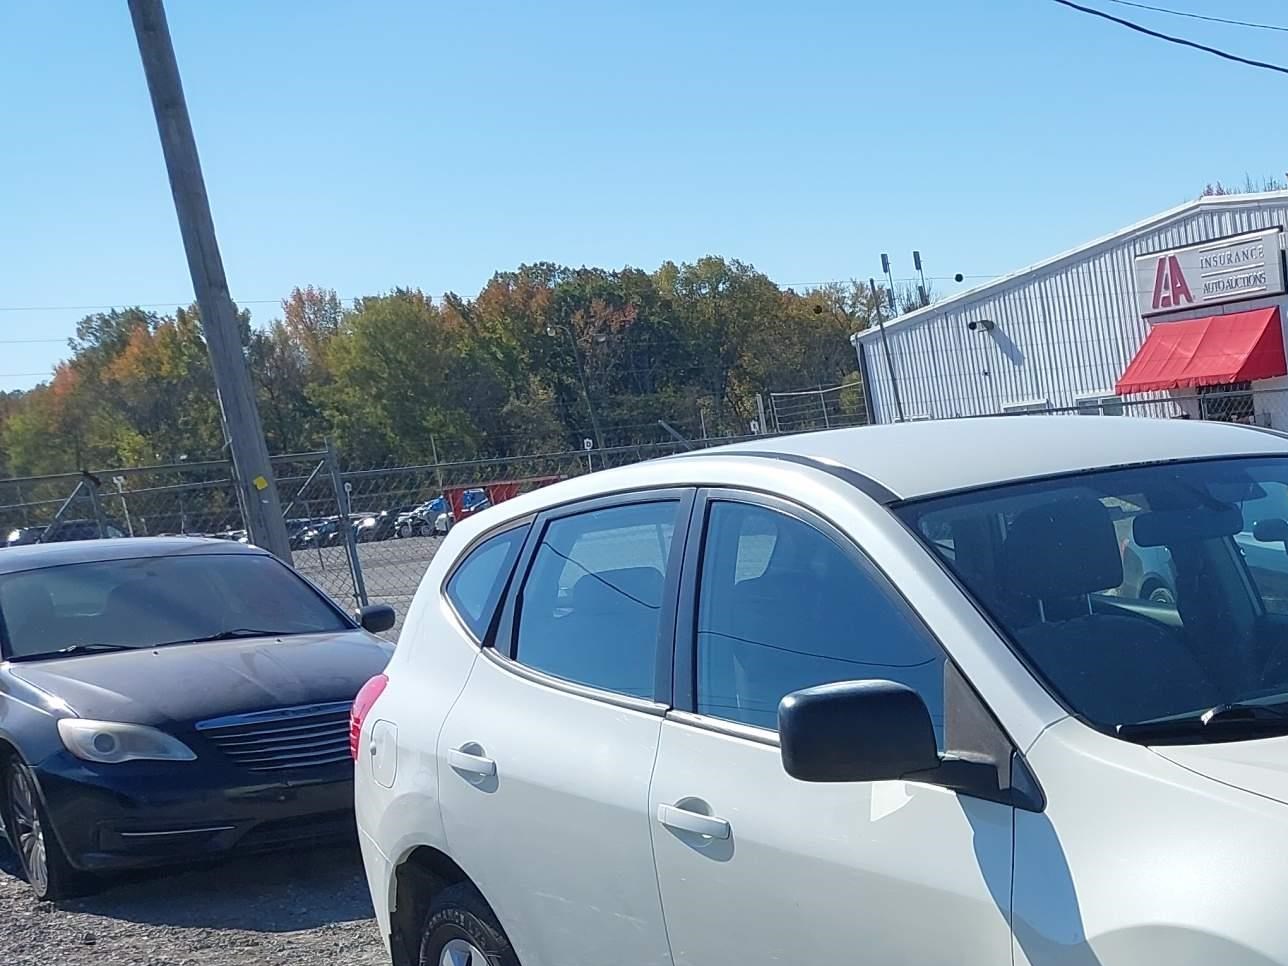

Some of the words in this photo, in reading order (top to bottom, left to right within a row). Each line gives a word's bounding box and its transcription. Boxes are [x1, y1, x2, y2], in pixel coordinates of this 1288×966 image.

[1200, 245, 1264, 270] INSURANCE
[1203, 279, 1225, 294] AUTO
[1225, 270, 1267, 291] AUCTIONS
